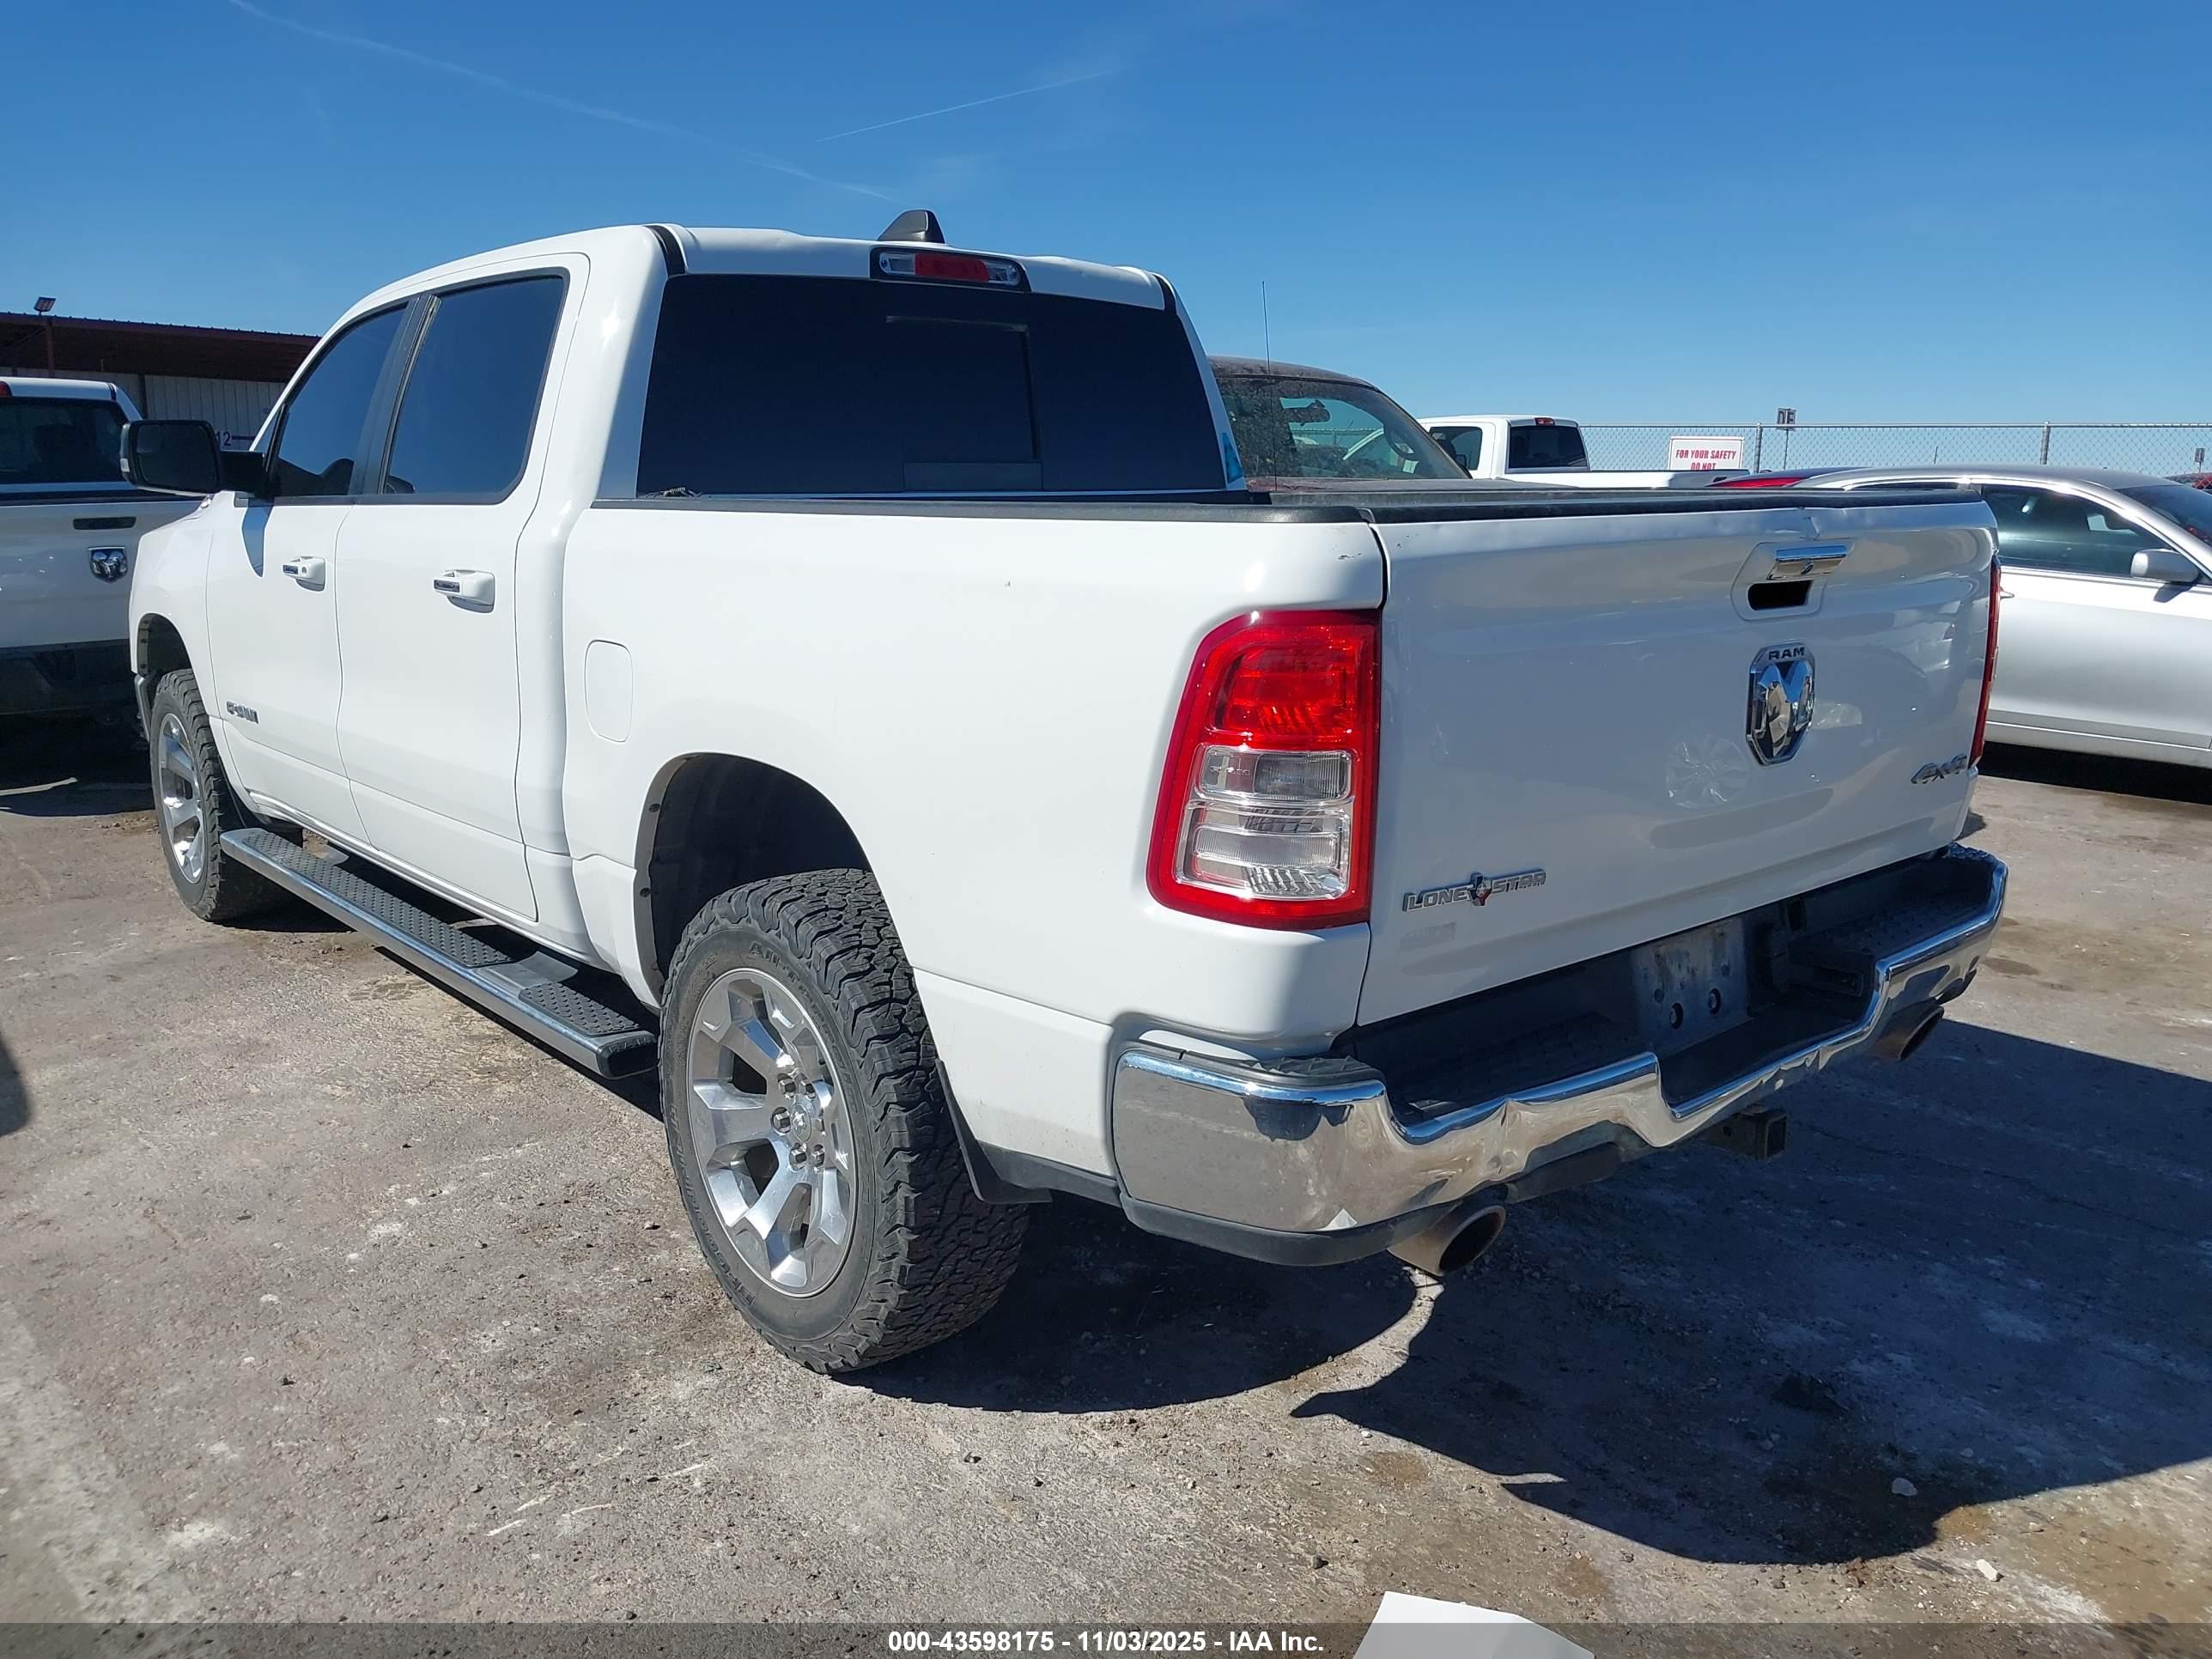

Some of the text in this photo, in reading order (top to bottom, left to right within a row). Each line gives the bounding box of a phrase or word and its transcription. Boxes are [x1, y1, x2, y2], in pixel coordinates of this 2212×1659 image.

[1675, 449, 1737, 460] FOR YOUR SAFETY
[1702, 462, 1717, 471] NOT
[1769, 646, 1805, 660] RAM
[1402, 871, 1547, 912] LONE STAR
